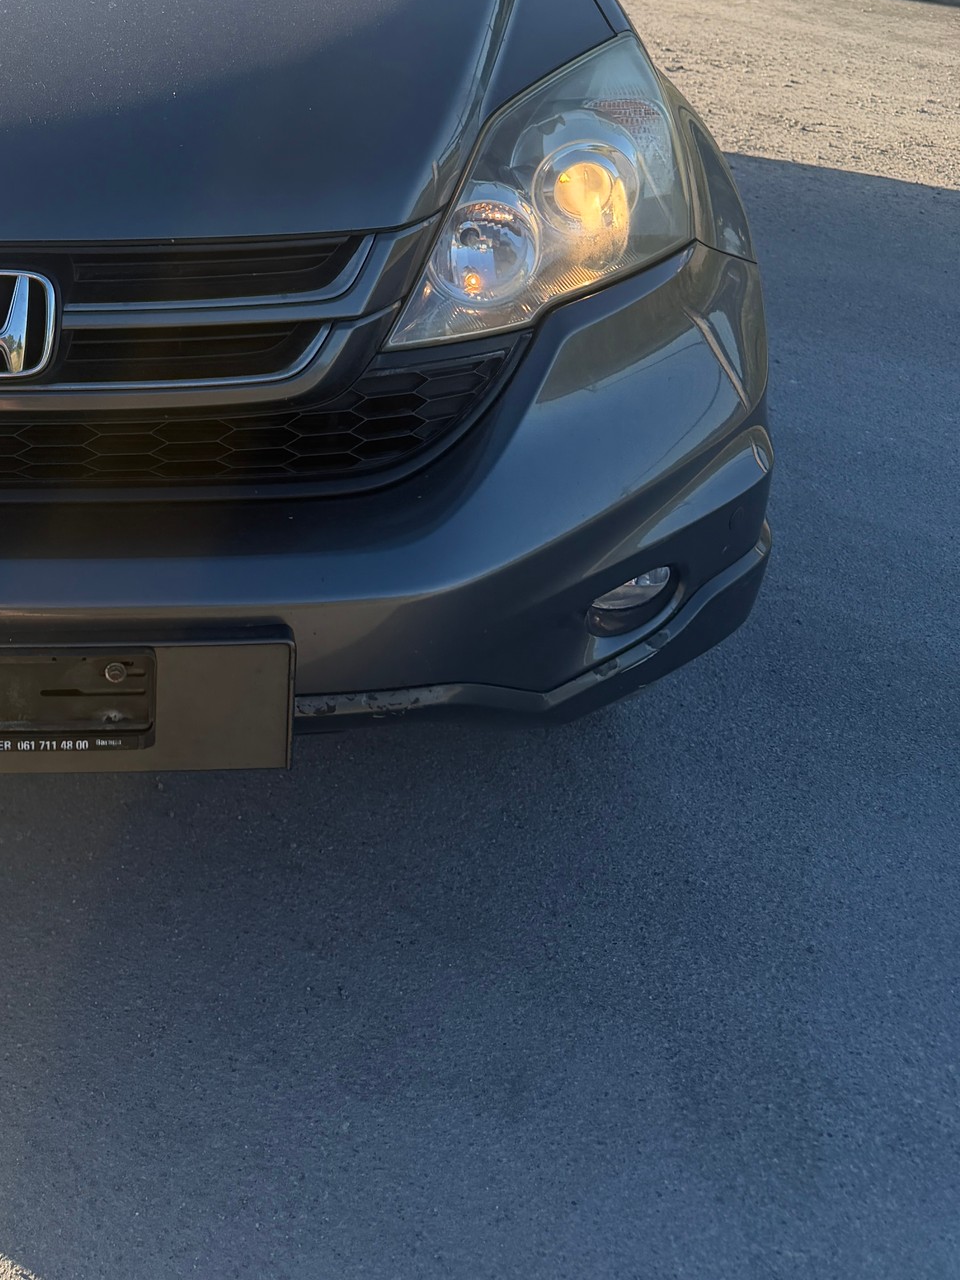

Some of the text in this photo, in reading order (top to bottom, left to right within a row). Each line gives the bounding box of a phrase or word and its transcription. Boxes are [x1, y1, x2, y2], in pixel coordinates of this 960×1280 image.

[17, 740, 35, 751] 061
[39, 740, 57, 751] 711
[60, 740, 73, 751] 48
[76, 740, 89, 751] 00
